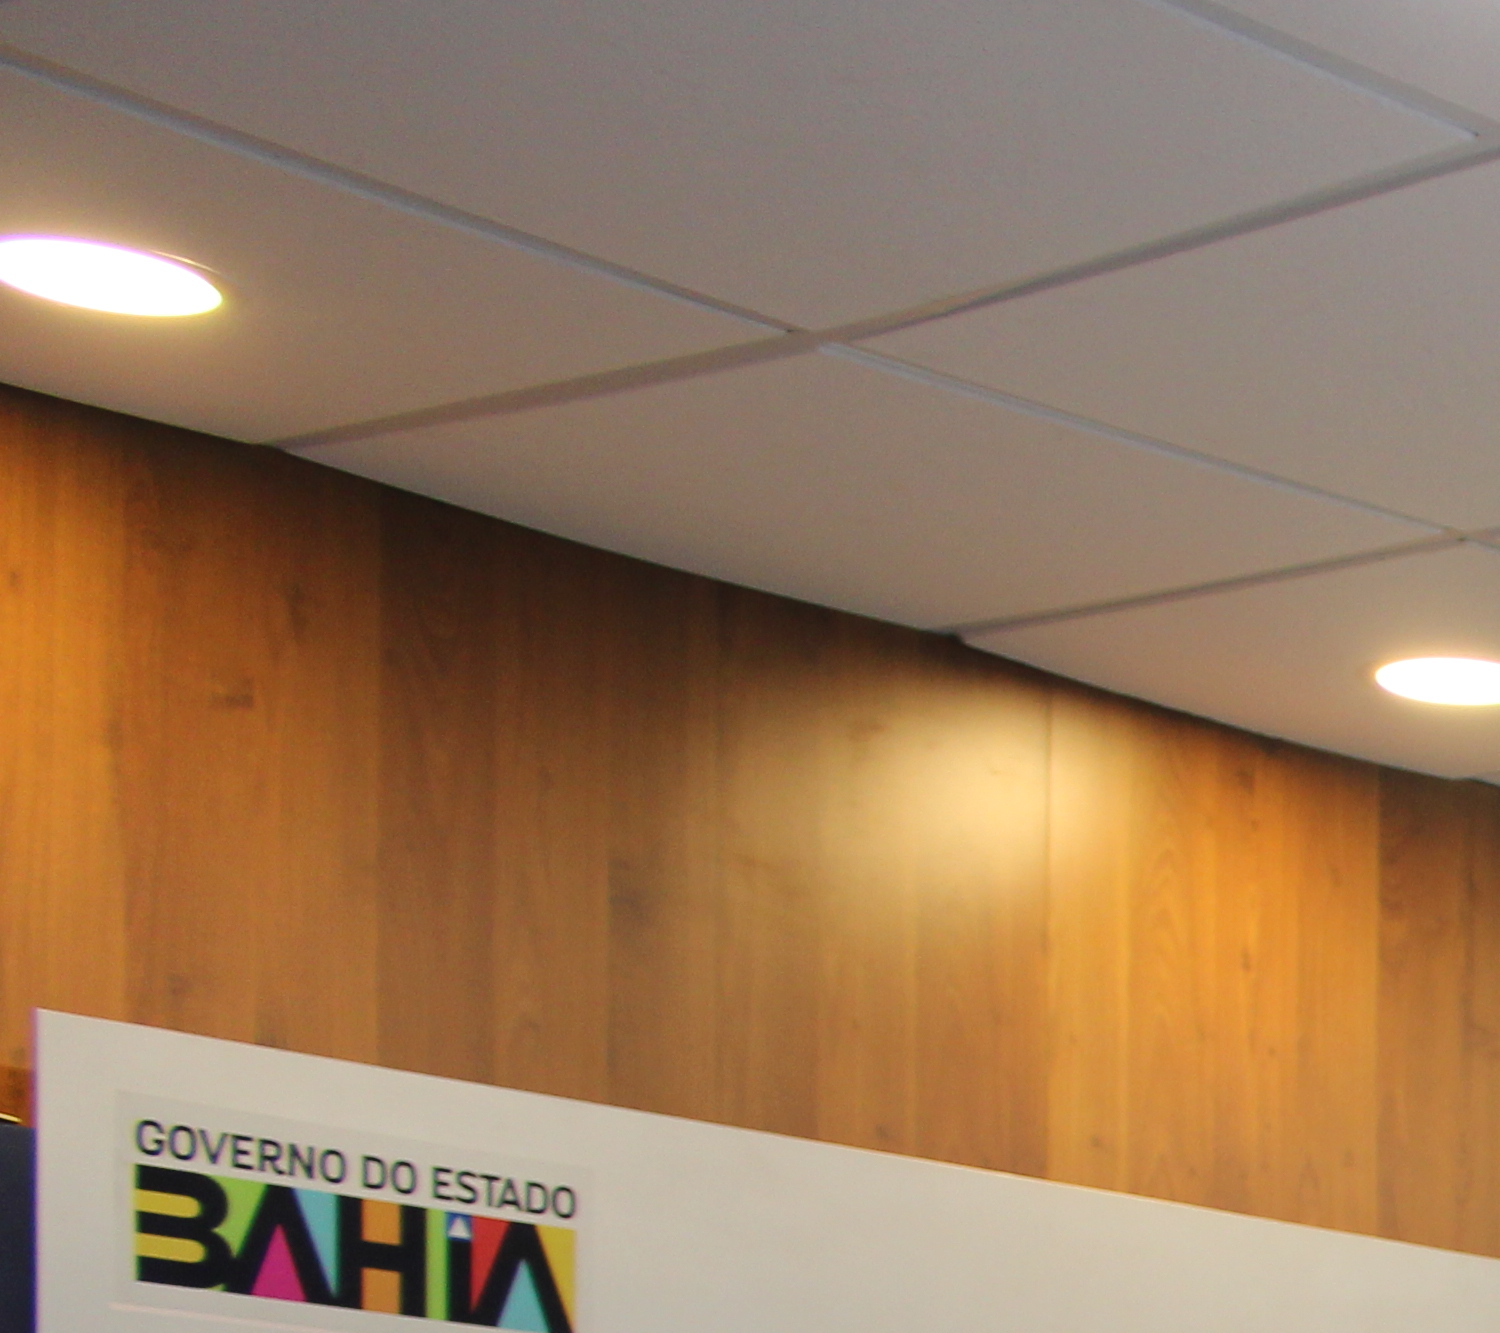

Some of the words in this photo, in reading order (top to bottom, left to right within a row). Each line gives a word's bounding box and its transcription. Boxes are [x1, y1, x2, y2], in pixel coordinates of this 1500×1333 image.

[135, 1119, 347, 1183] GOVERNO
[362, 1154, 416, 1193] DO
[432, 1165, 576, 1218] ESTADO
